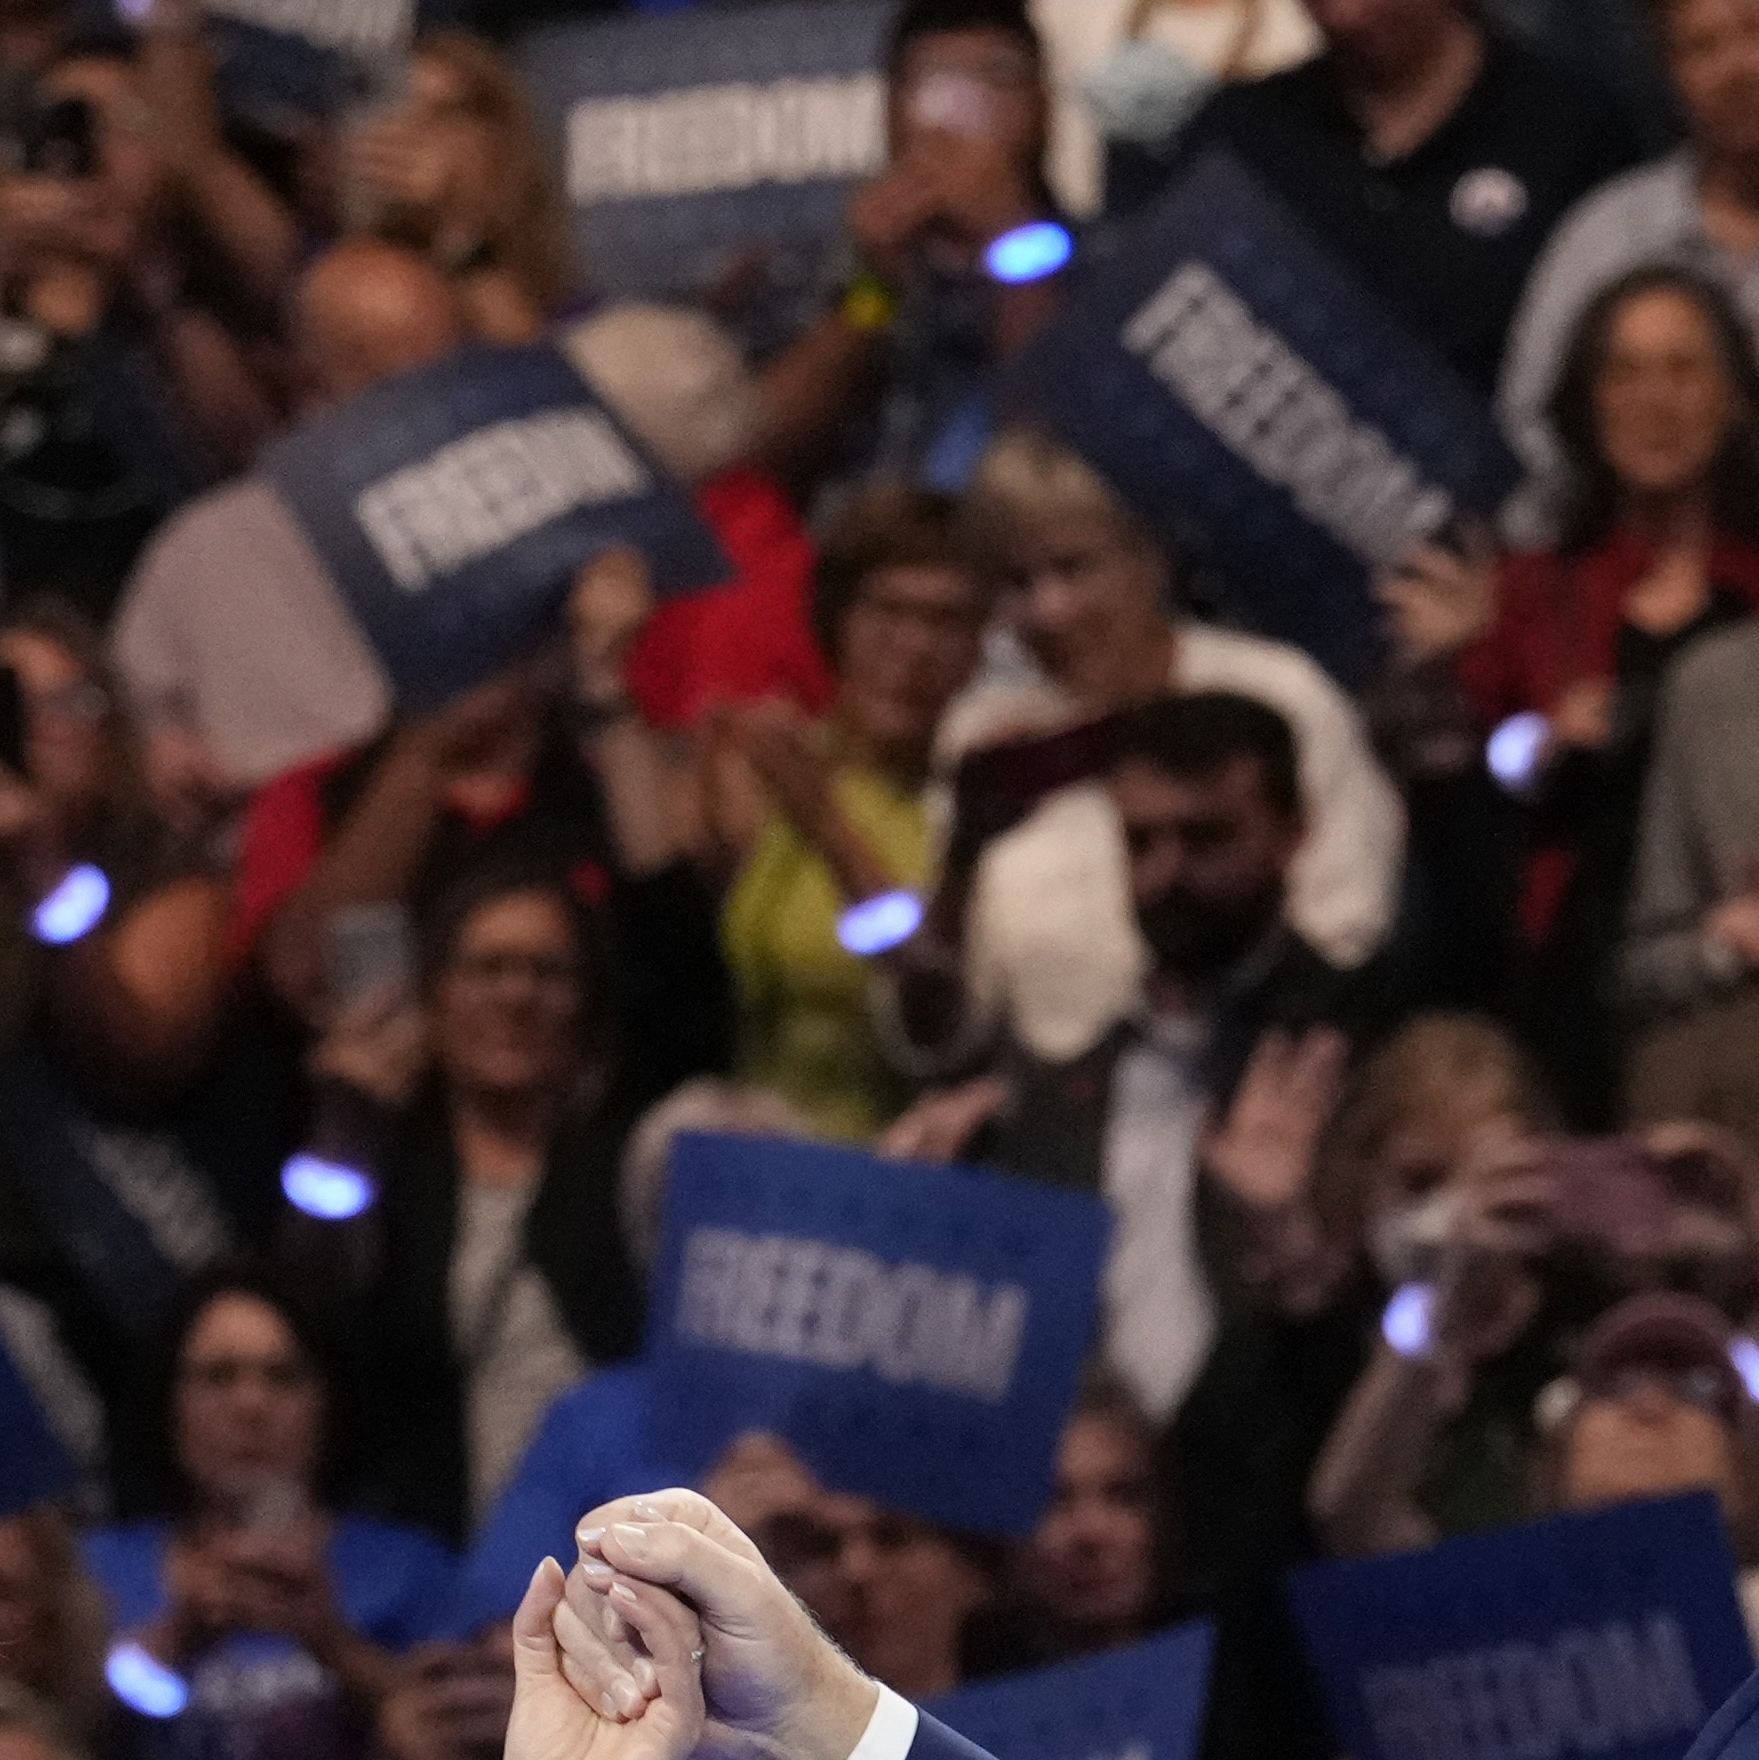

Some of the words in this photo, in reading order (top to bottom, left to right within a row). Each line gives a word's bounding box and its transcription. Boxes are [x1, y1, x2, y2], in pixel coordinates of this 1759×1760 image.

[354, 408, 650, 592] FREEDOM
[1122, 262, 1454, 568] FREEDOM
[674, 1225, 1030, 1404] FREEDOM
